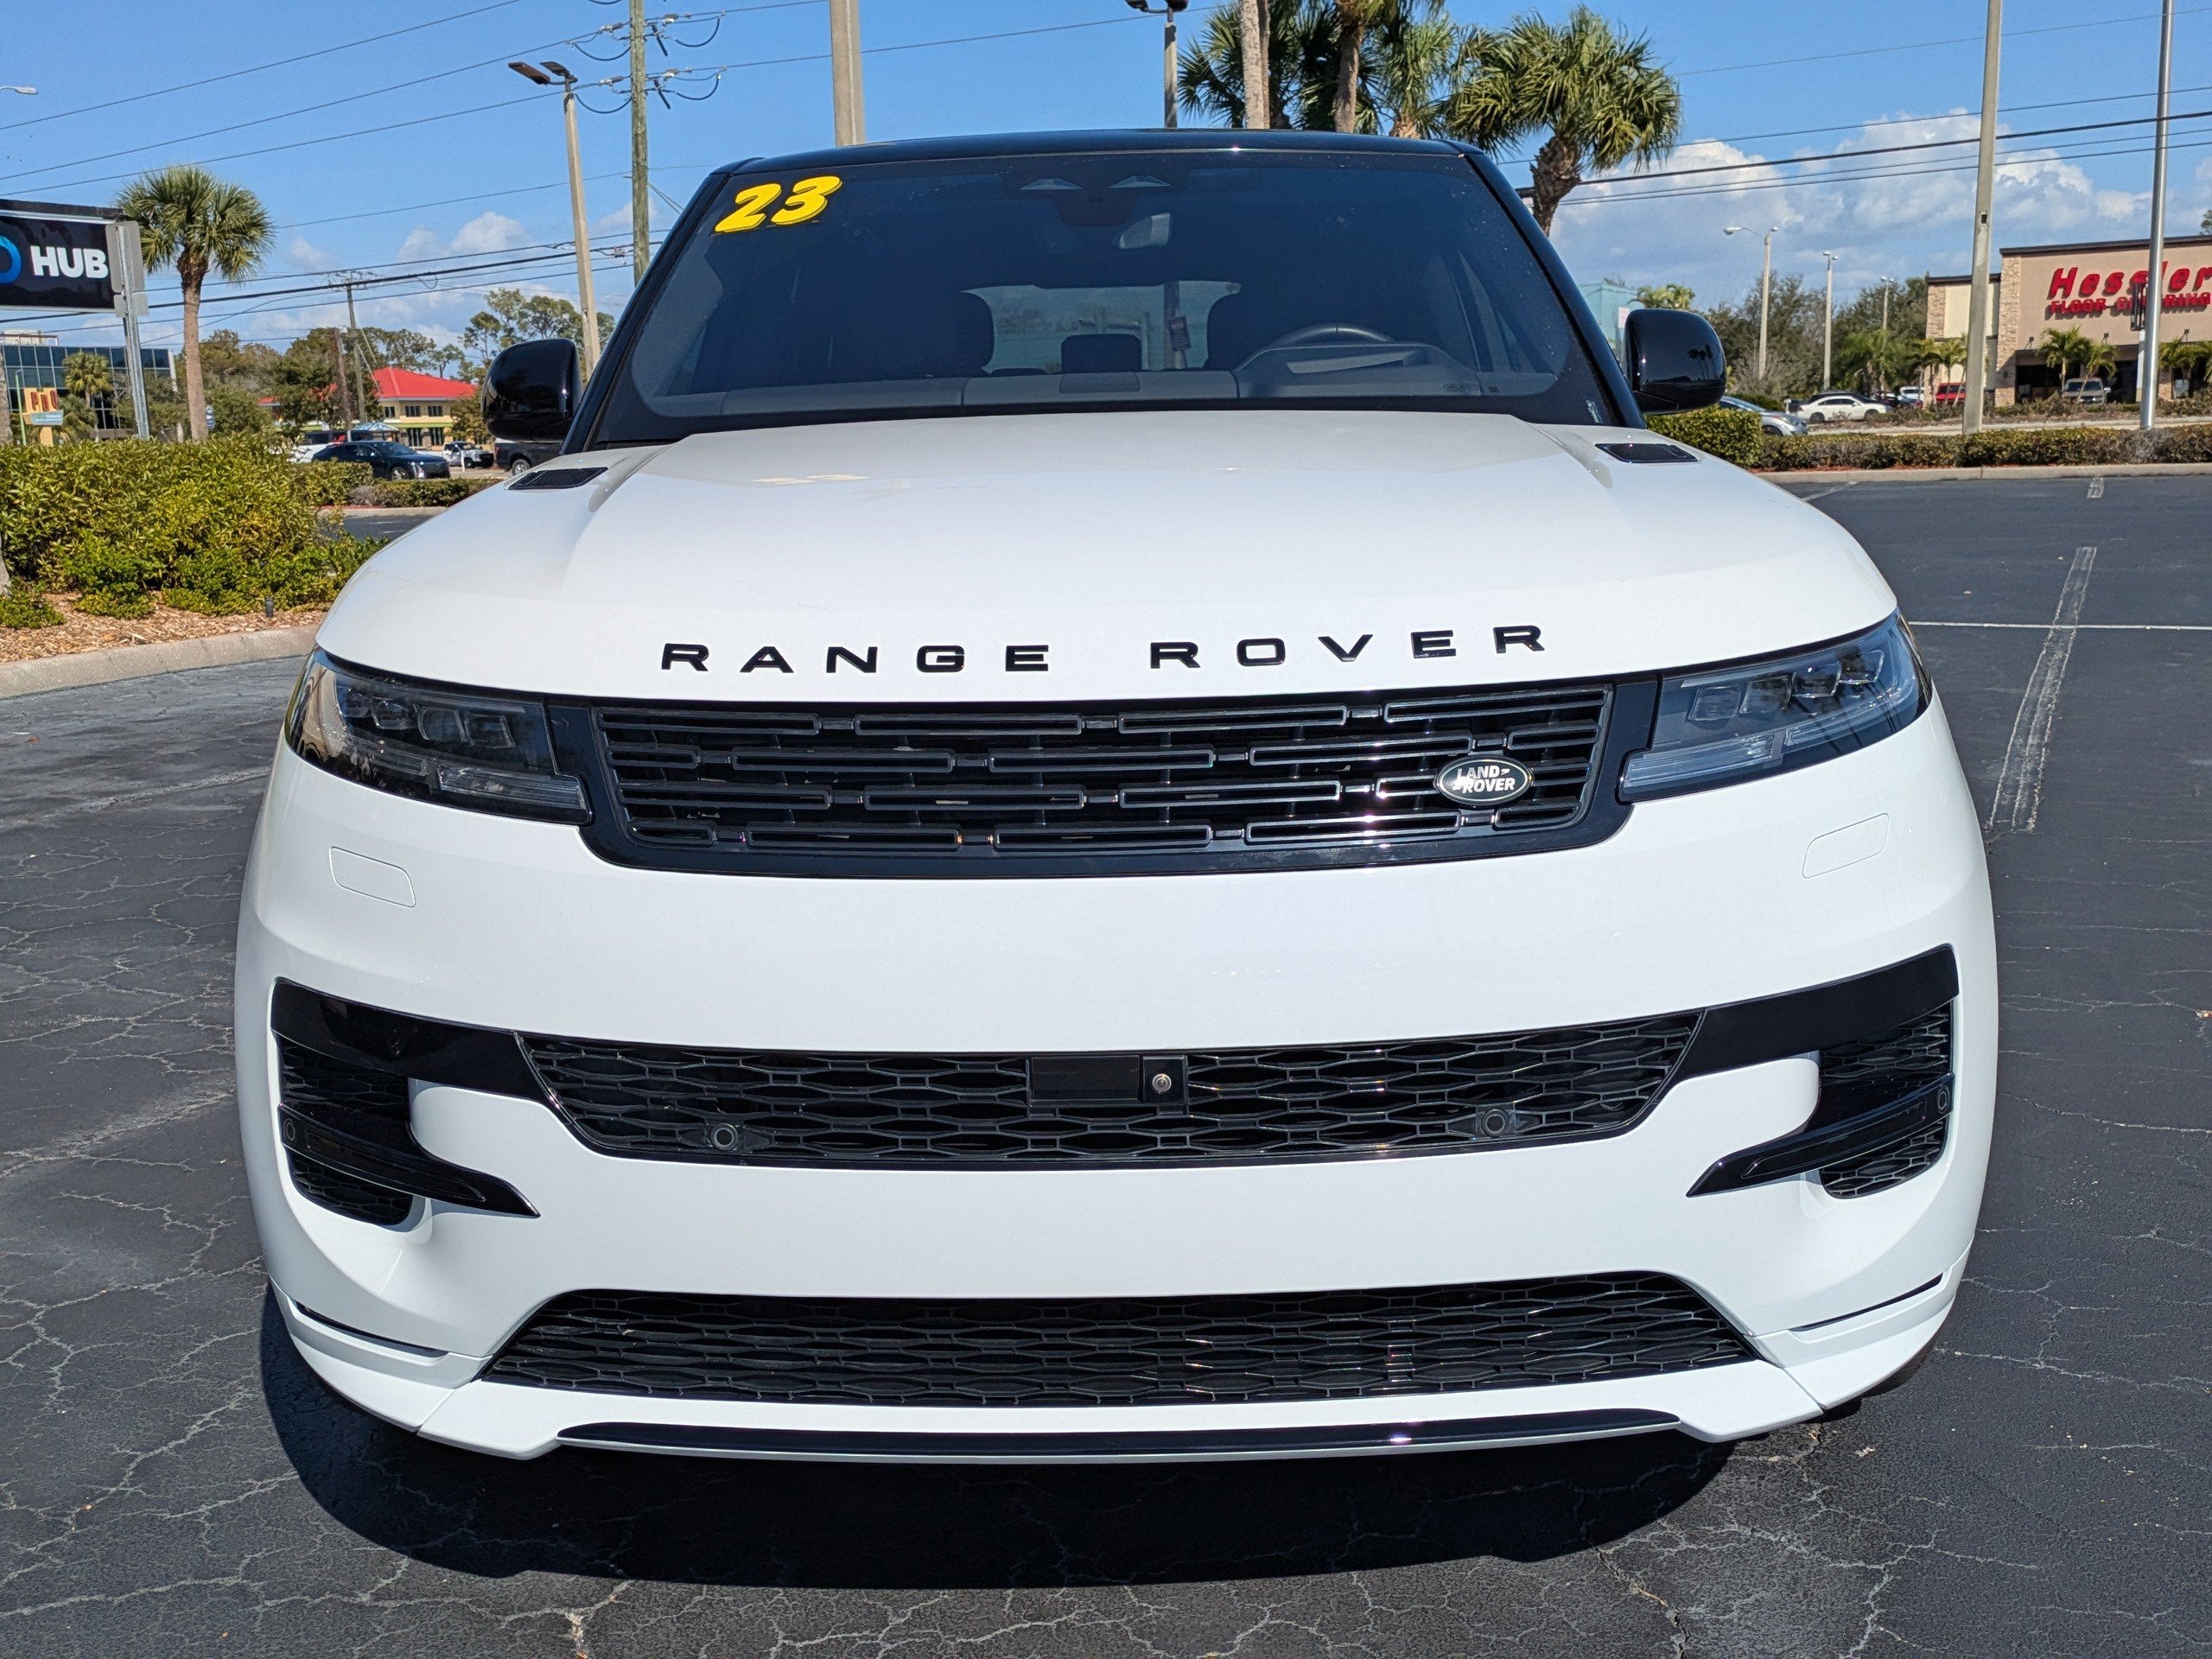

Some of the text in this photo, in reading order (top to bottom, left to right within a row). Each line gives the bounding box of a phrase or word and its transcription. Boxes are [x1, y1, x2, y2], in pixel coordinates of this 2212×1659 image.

[715, 175, 842, 233] 23
[30, 245, 109, 279] HUB
[2049, 298, 2107, 315] FLOOR
[661, 624, 1545, 673] RANGE ROVER
[1457, 766, 1500, 779] LAND
[1461, 778, 1516, 793] ROVER
